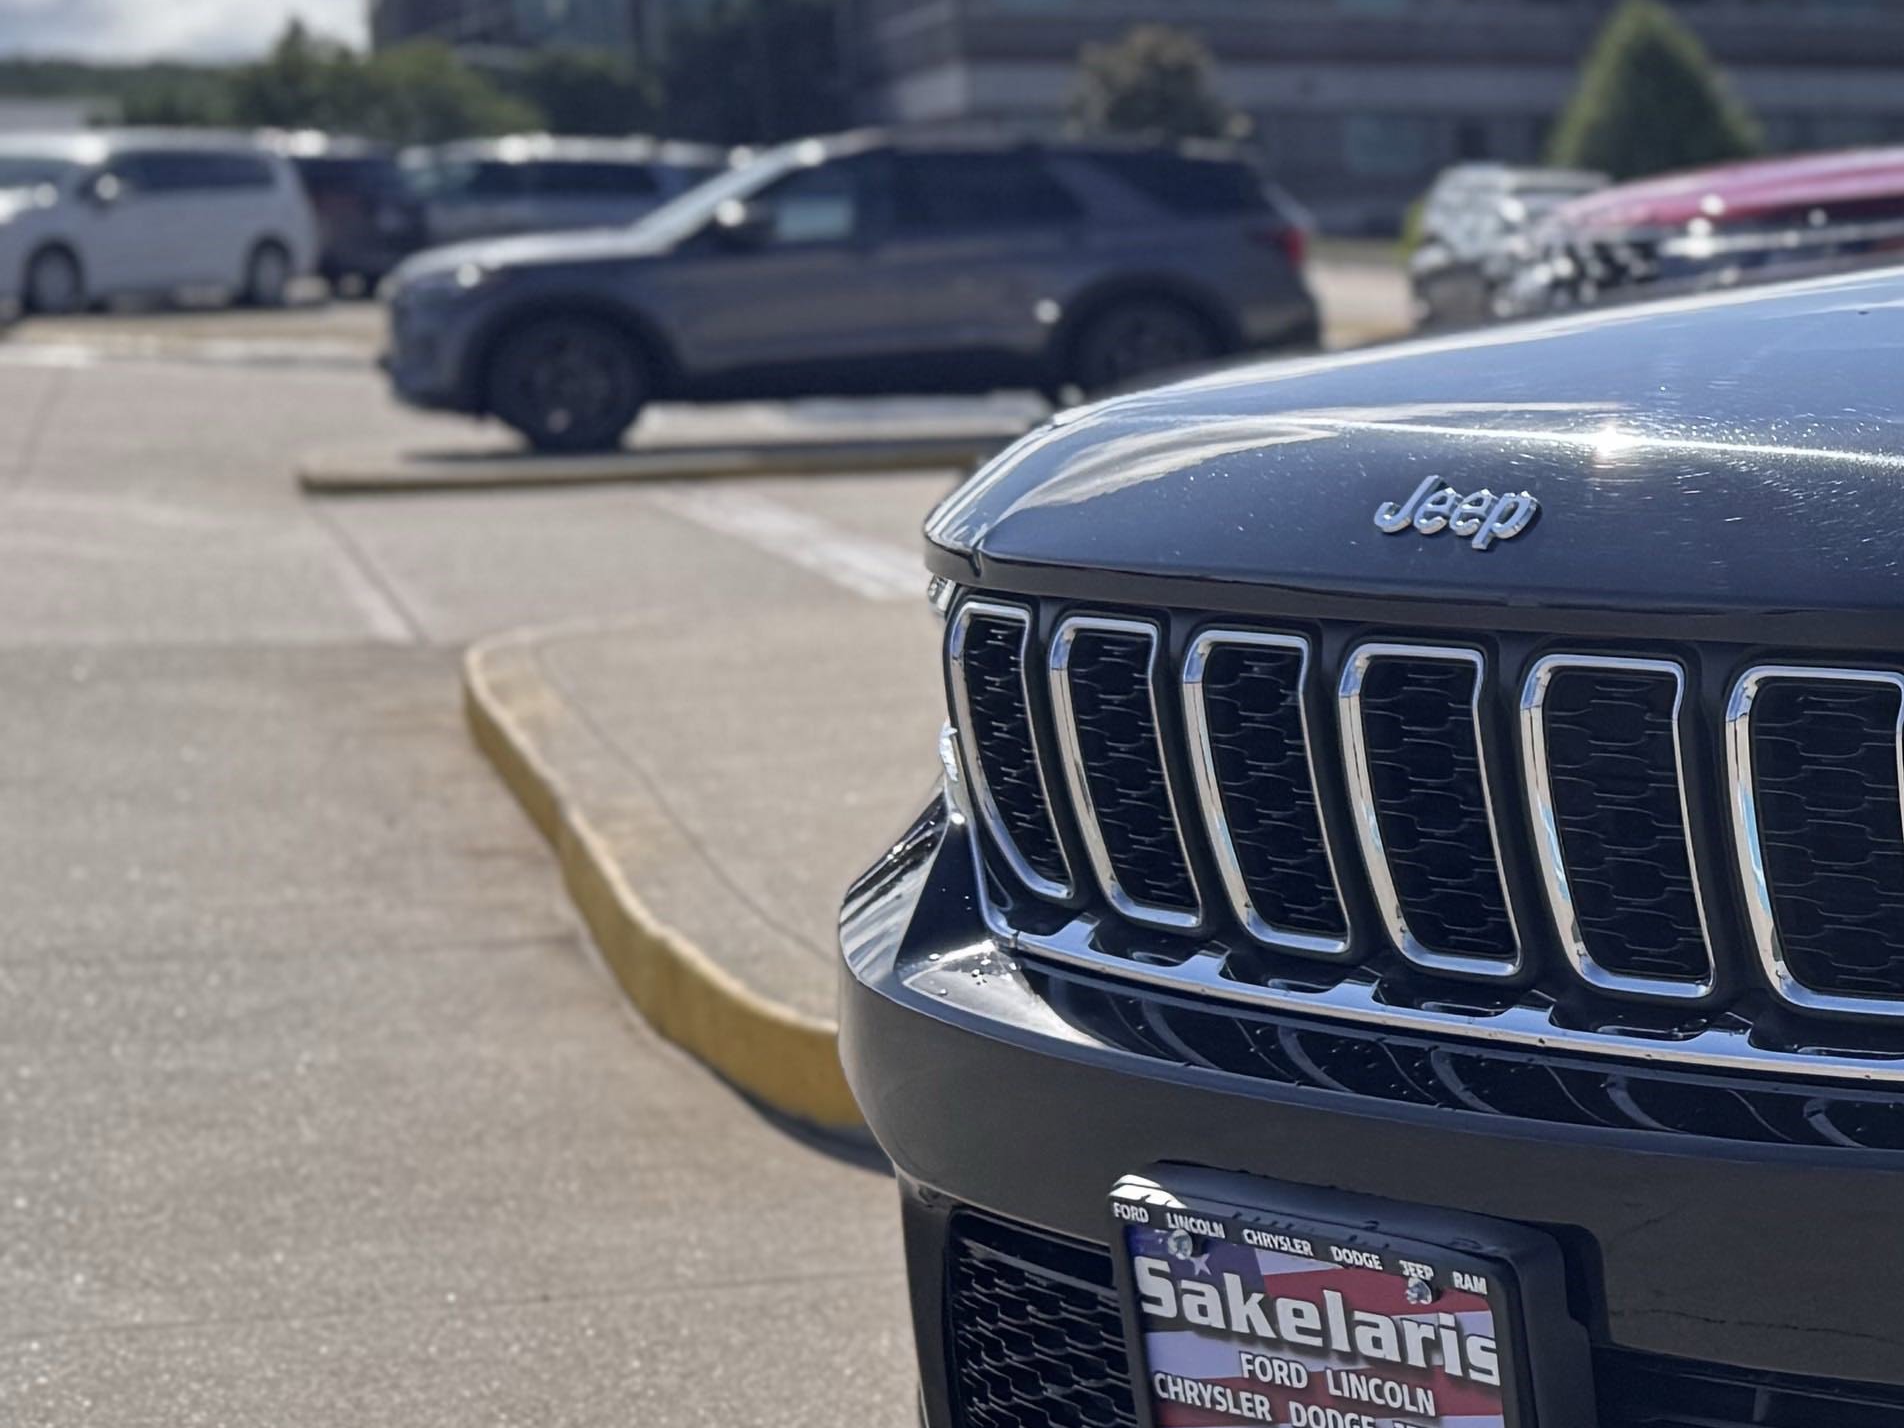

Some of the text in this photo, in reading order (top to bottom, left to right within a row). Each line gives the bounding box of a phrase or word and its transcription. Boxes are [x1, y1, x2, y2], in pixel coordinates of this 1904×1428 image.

[1373, 474, 1540, 551] Jeep
[1113, 1202, 1489, 1297] FORD LINCOLN CHRYSLER DODGE JEEP RAM
[1134, 1255, 1502, 1387] Sakelaris
[1154, 1372, 1273, 1422] CHRYSLER
[1239, 1351, 1437, 1418] FORD LINCOLN
